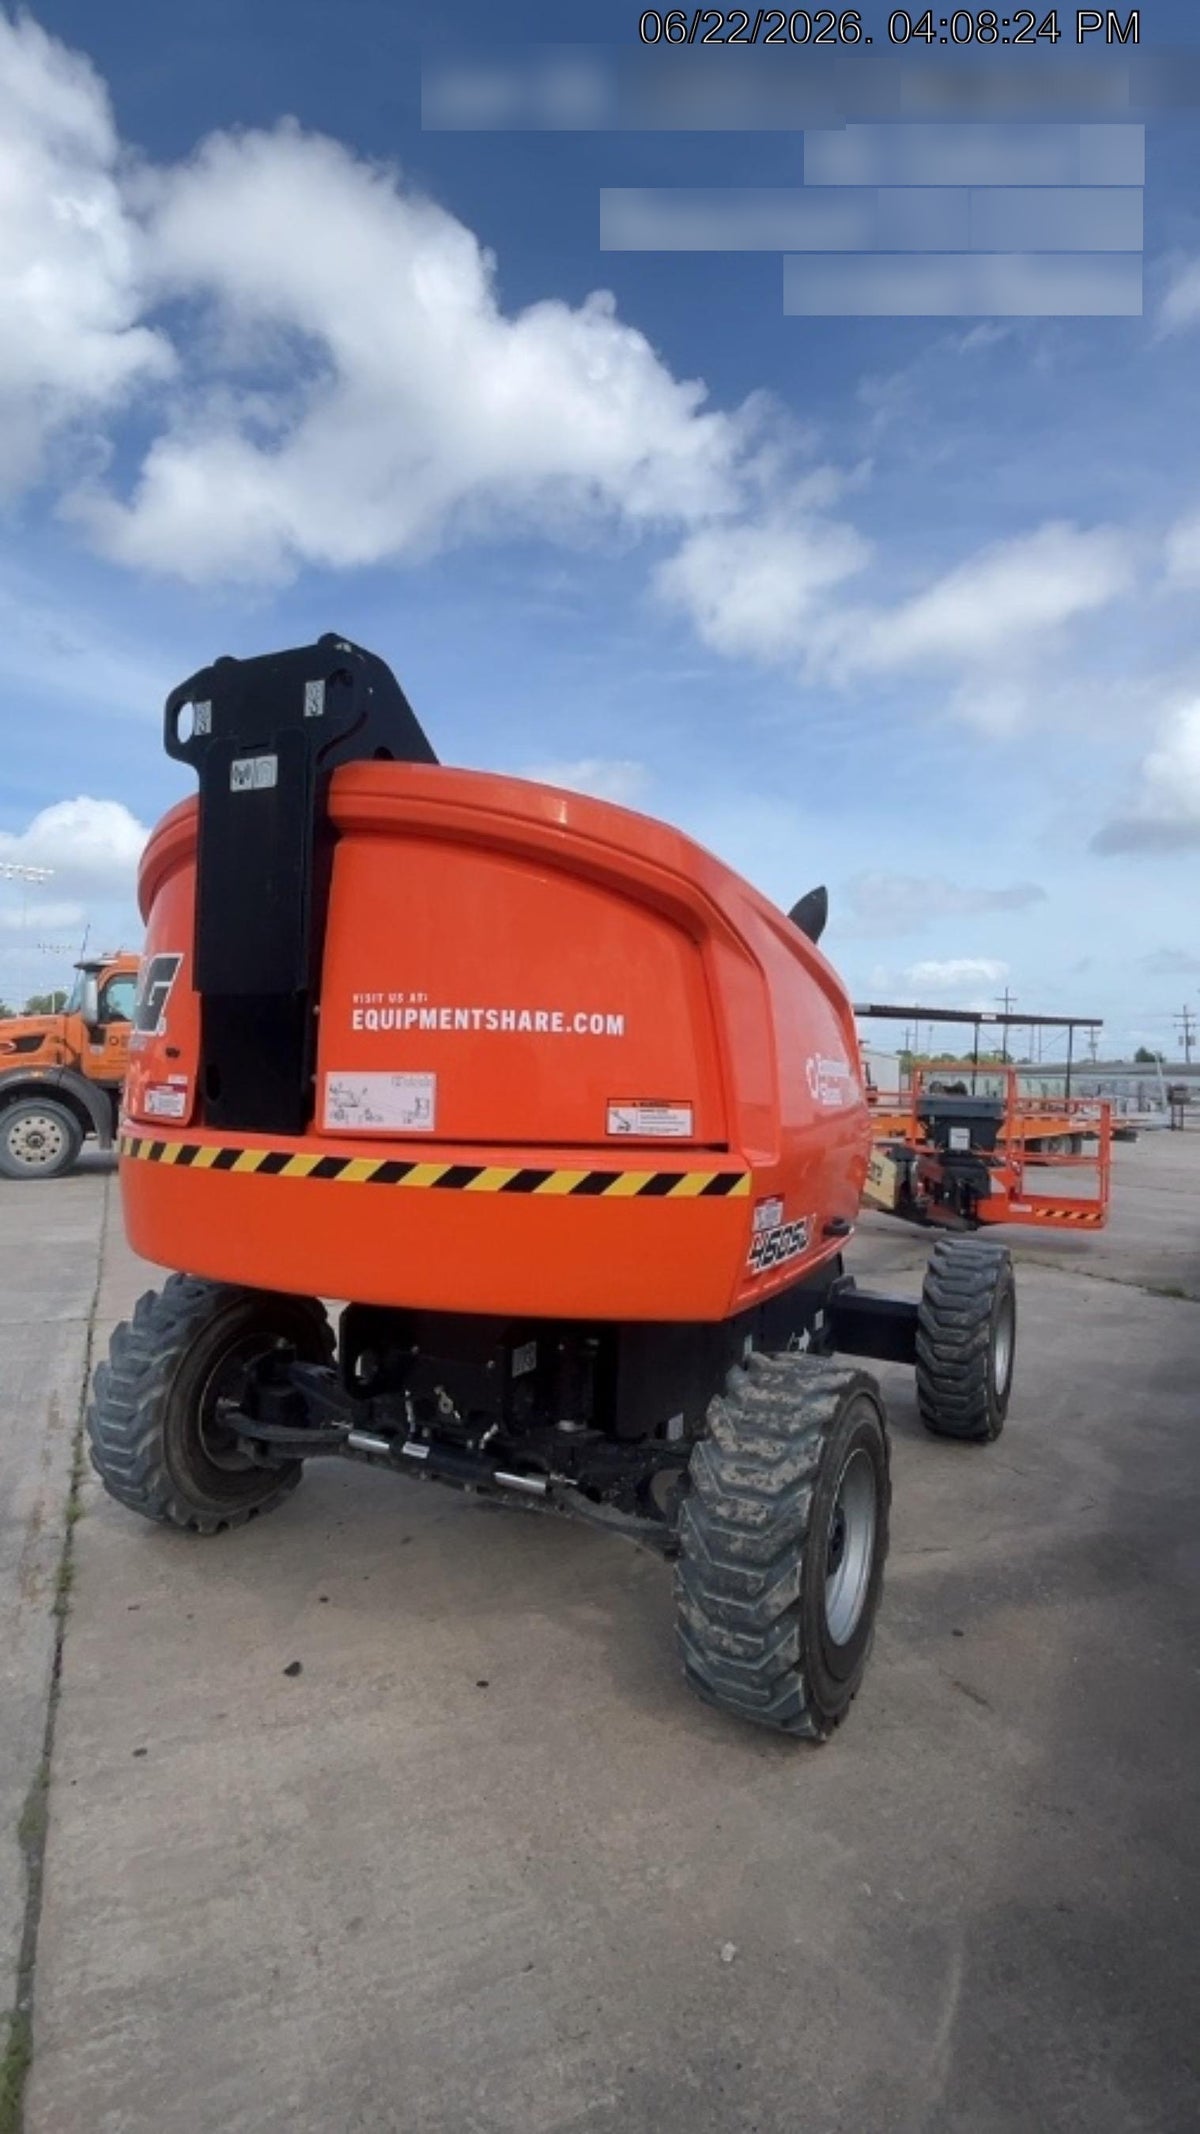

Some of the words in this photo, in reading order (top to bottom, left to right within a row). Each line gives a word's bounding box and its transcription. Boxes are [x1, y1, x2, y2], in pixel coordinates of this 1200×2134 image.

[352, 993, 384, 1004] VISIT
[388, 993, 405, 1004] US
[352, 1008, 625, 1036] EQUIPMENTSHARE.COM
